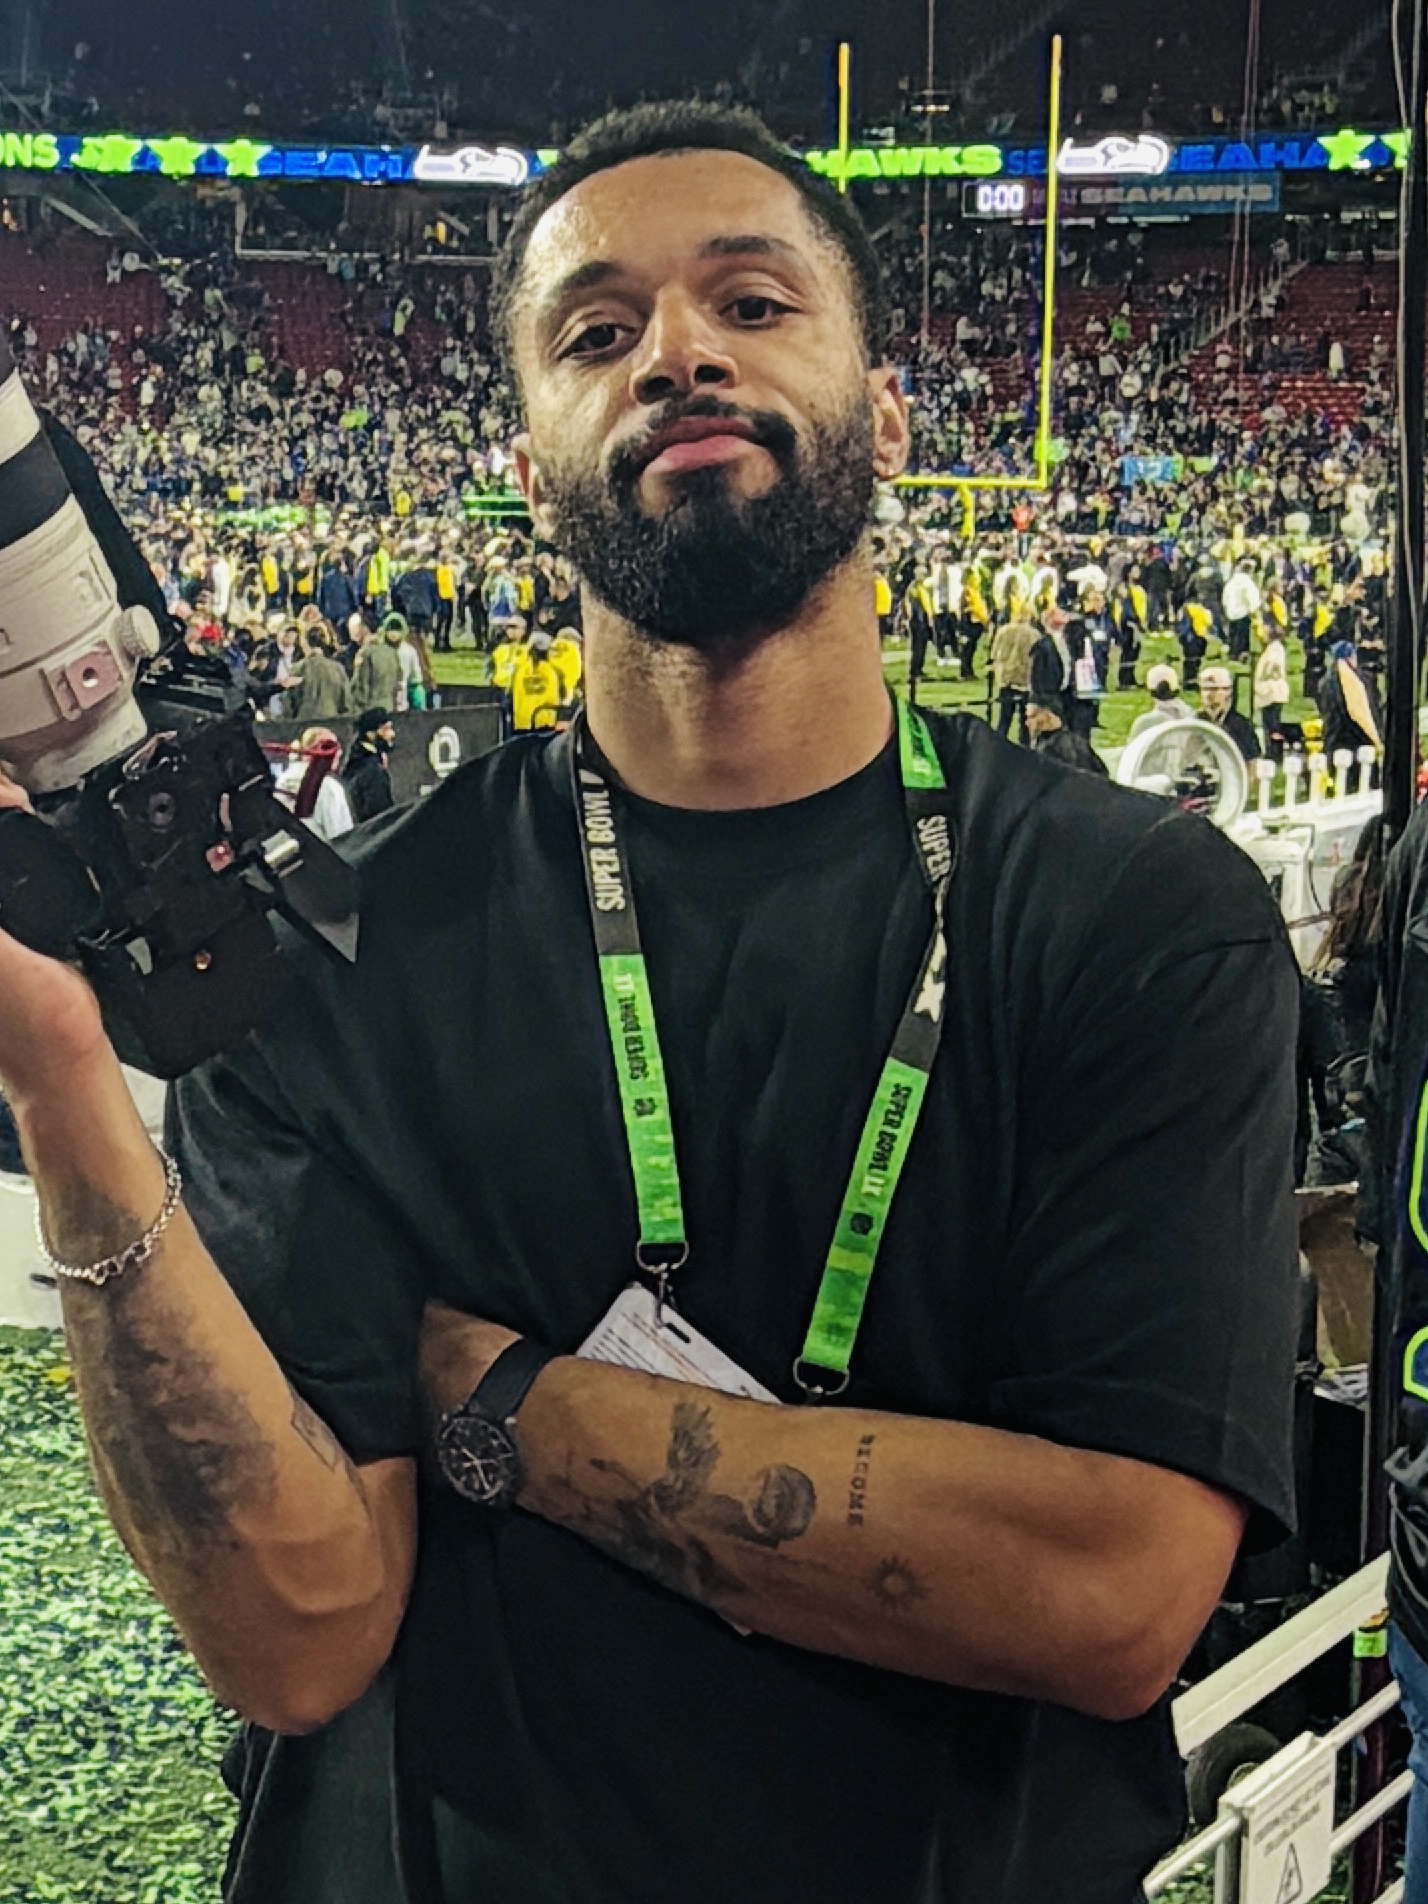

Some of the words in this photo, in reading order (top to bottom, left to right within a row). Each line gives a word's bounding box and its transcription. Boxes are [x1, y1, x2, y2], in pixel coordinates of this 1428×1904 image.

[1080, 183, 1274, 206] SEAHAWKS
[582, 789, 616, 844] BOWL
[916, 813, 952, 883] SUPER
[589, 846, 626, 912] SUPER
